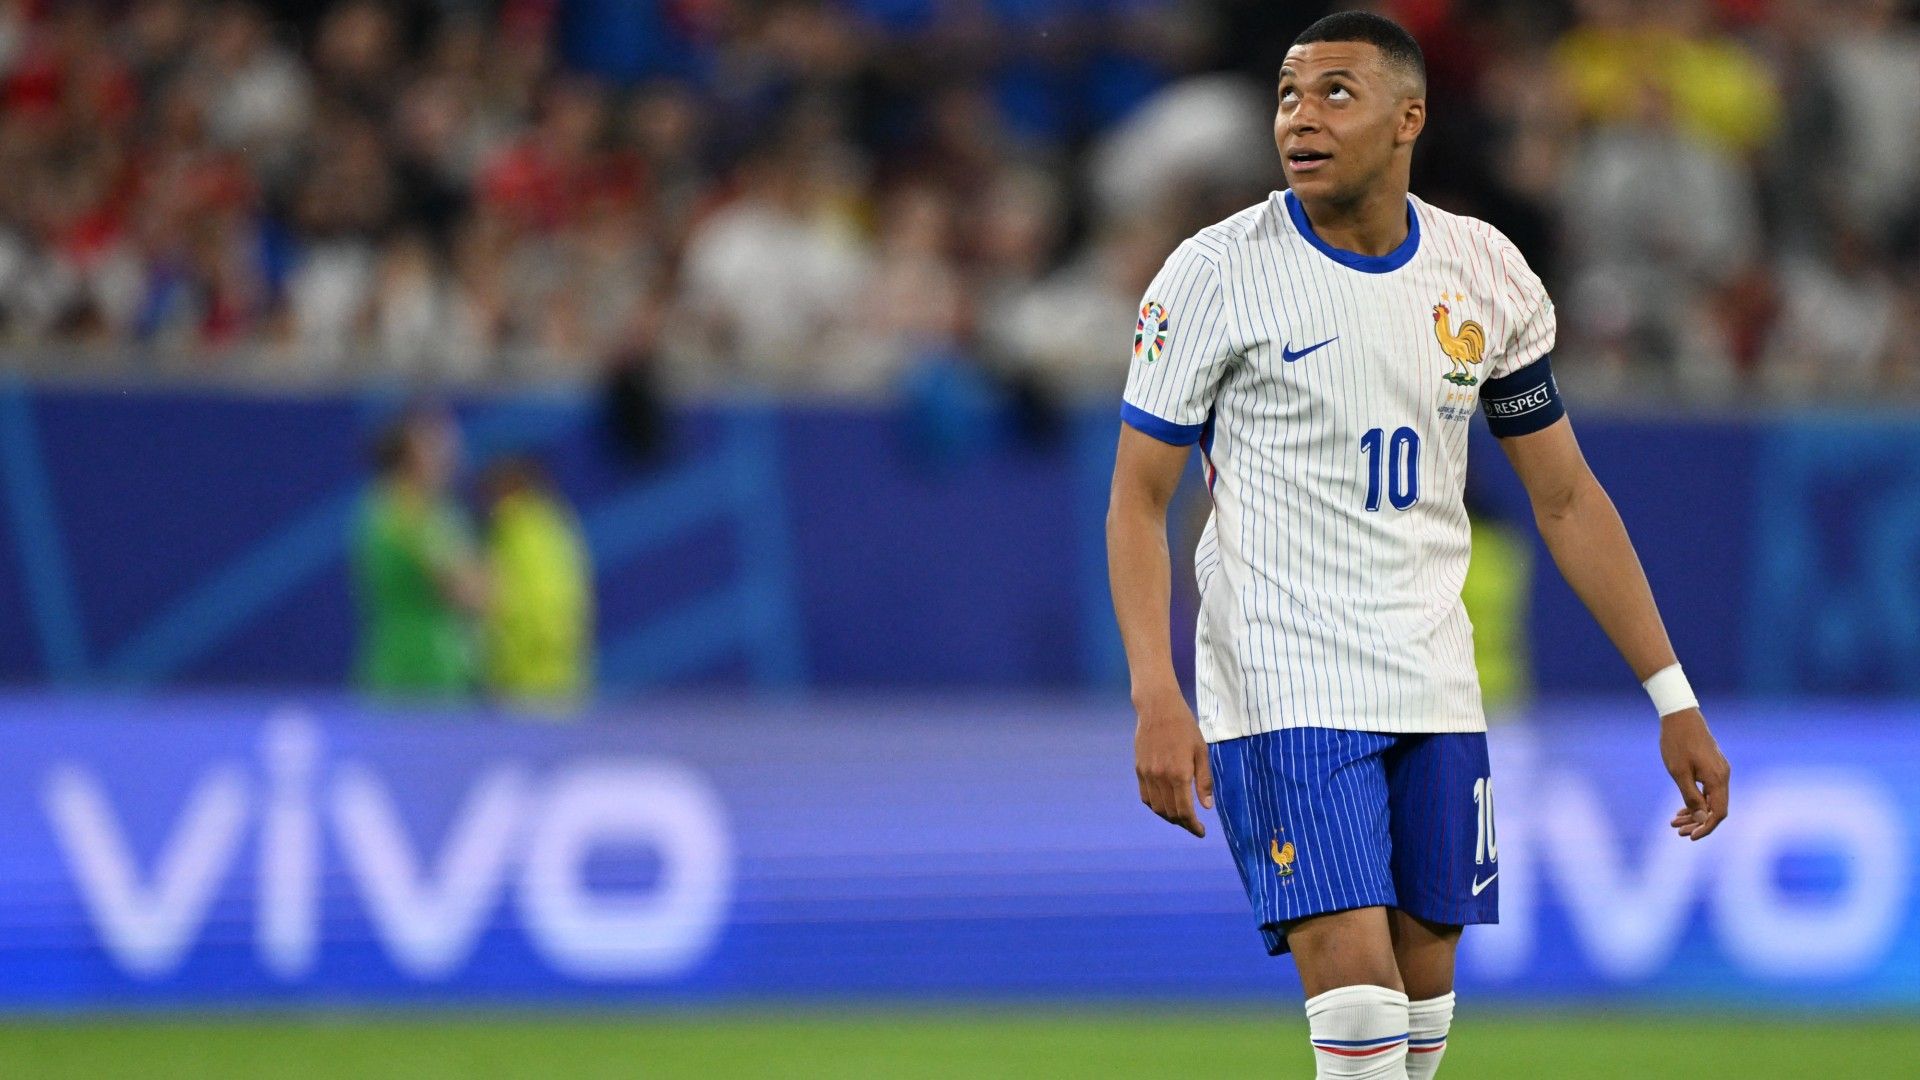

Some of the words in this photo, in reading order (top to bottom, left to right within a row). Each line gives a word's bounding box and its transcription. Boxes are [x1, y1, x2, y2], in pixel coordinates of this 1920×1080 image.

[1360, 426, 1421, 512] 10
[1494, 387, 1549, 414] RESPECT
[43, 713, 734, 981] vivo
[1468, 718, 1908, 982] ivo
